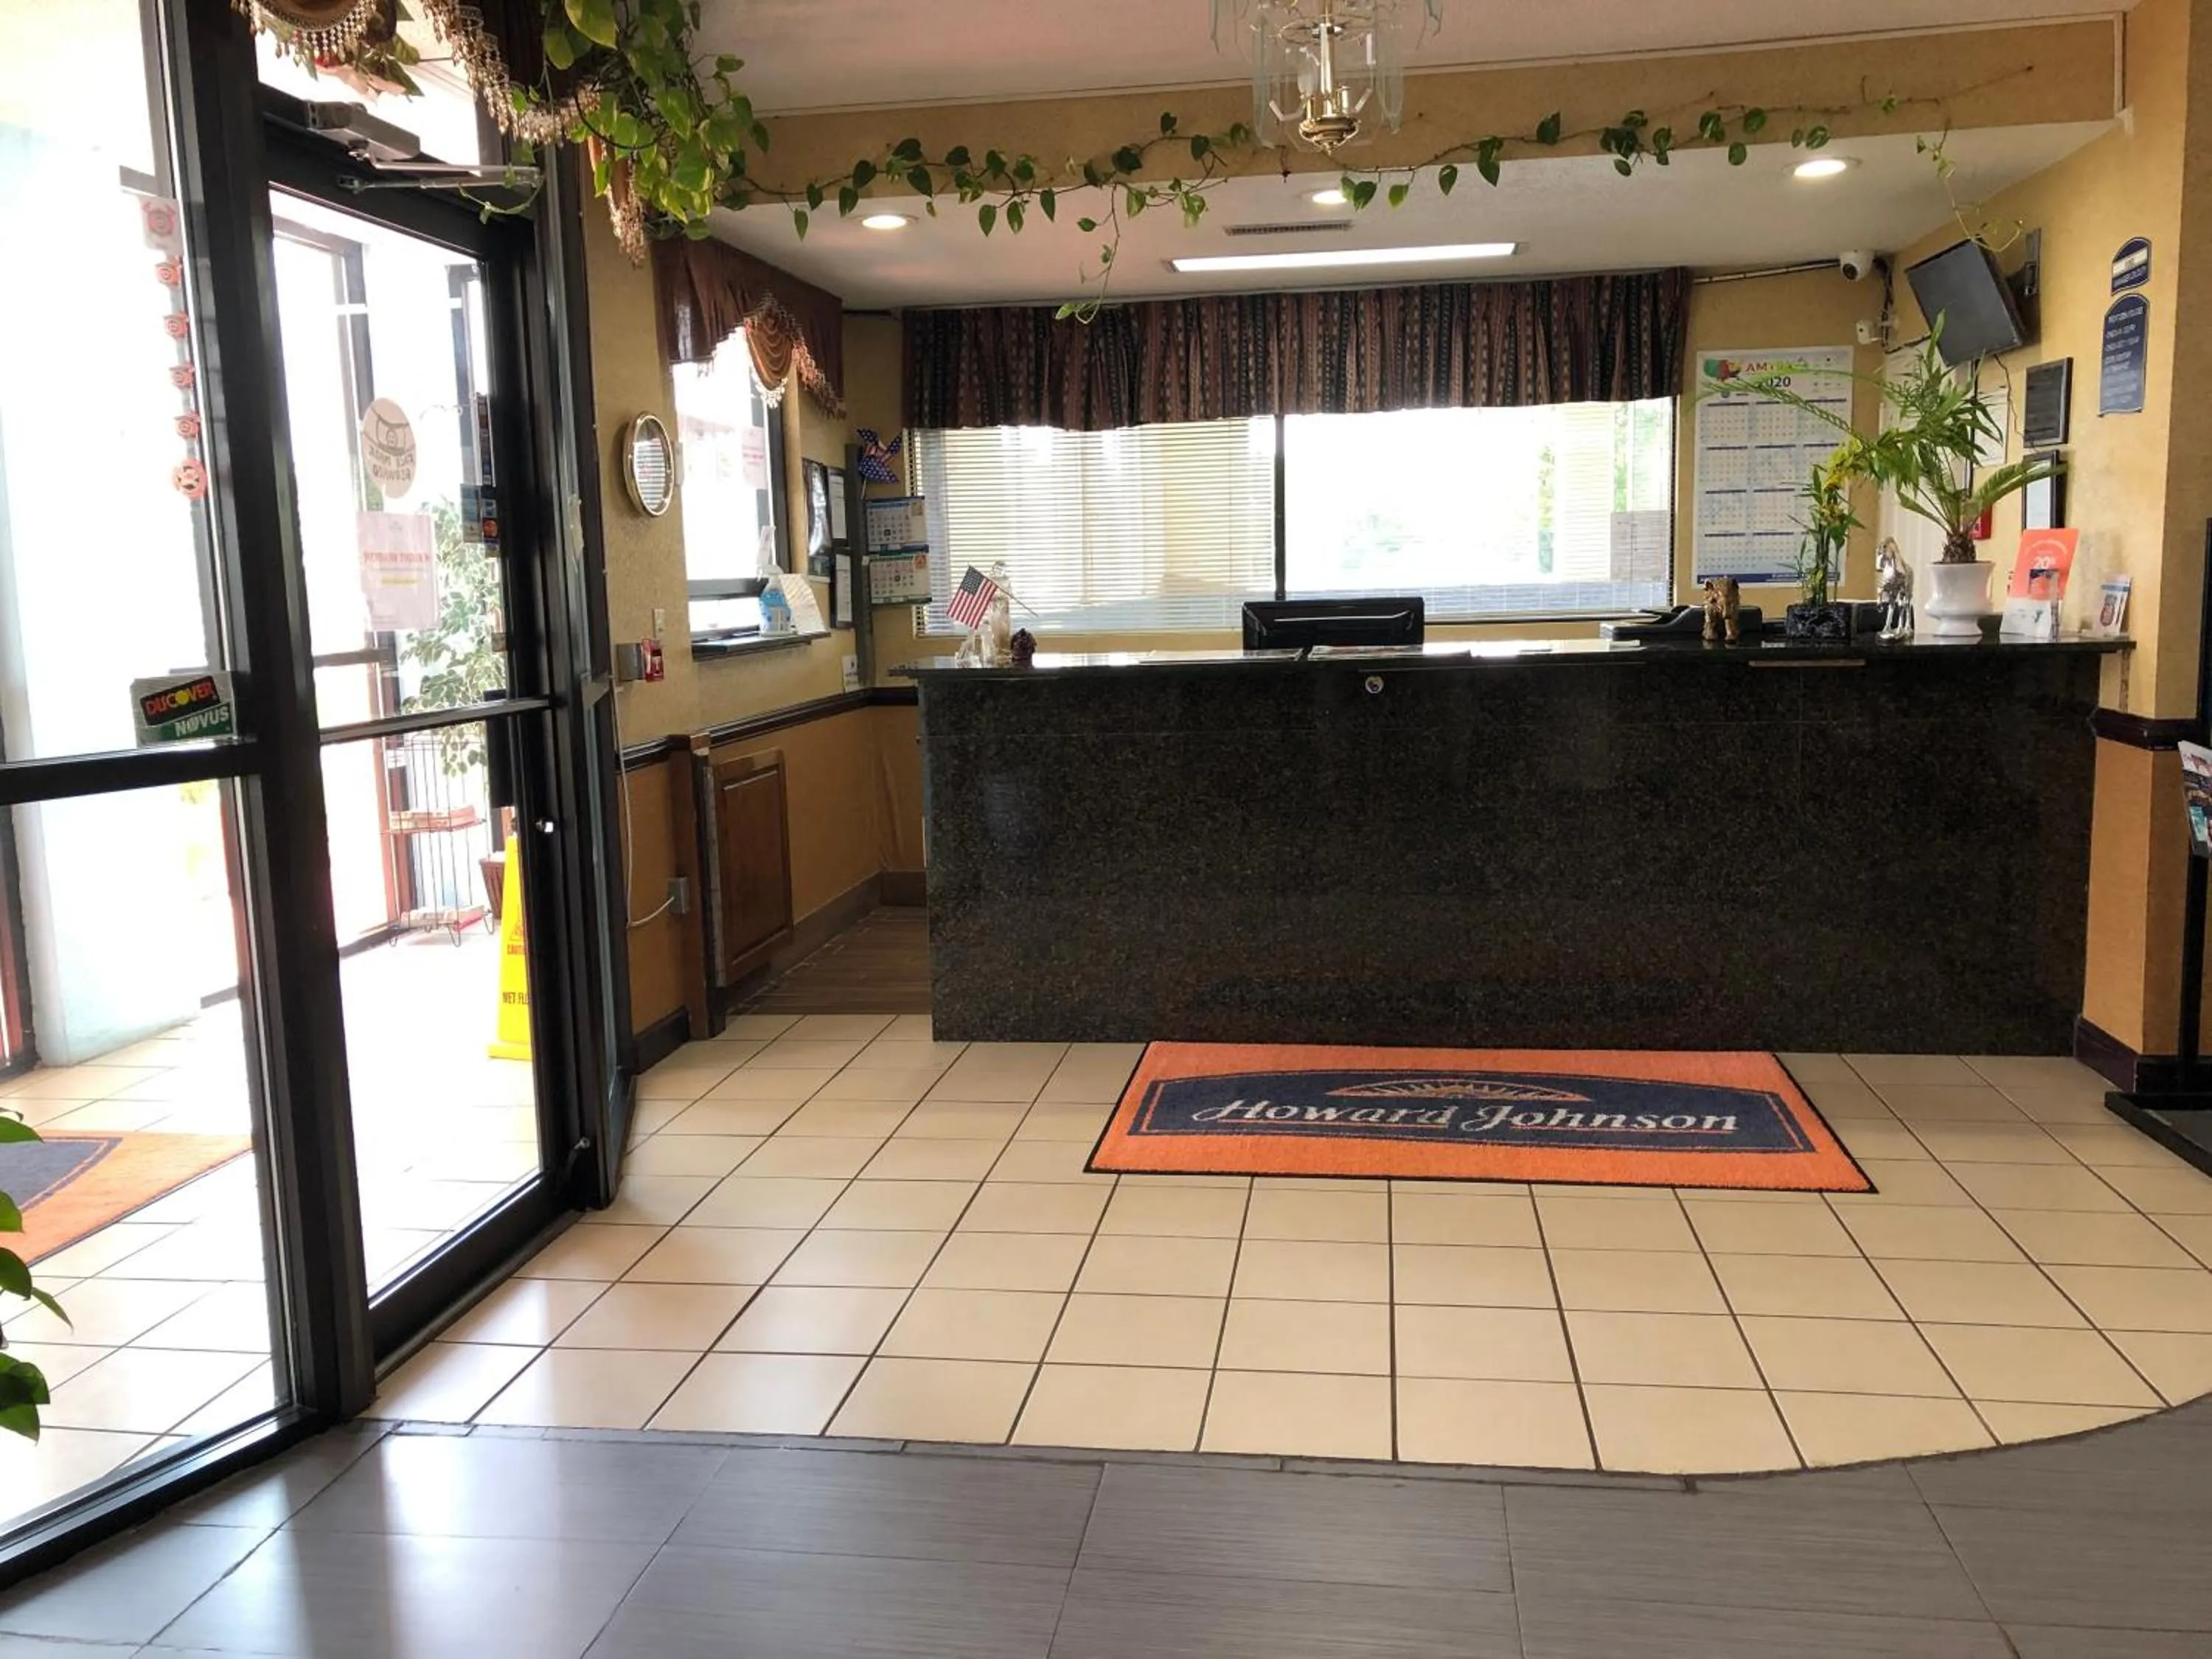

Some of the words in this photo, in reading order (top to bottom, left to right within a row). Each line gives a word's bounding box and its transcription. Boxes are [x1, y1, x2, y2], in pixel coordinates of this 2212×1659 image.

[145, 681, 215, 715] DISCOVER
[175, 706, 230, 737] NOVUS
[503, 992, 516, 1004] WET
[1191, 1099, 1458, 1124] Howard
[1460, 1105, 1739, 1132] Johnson
